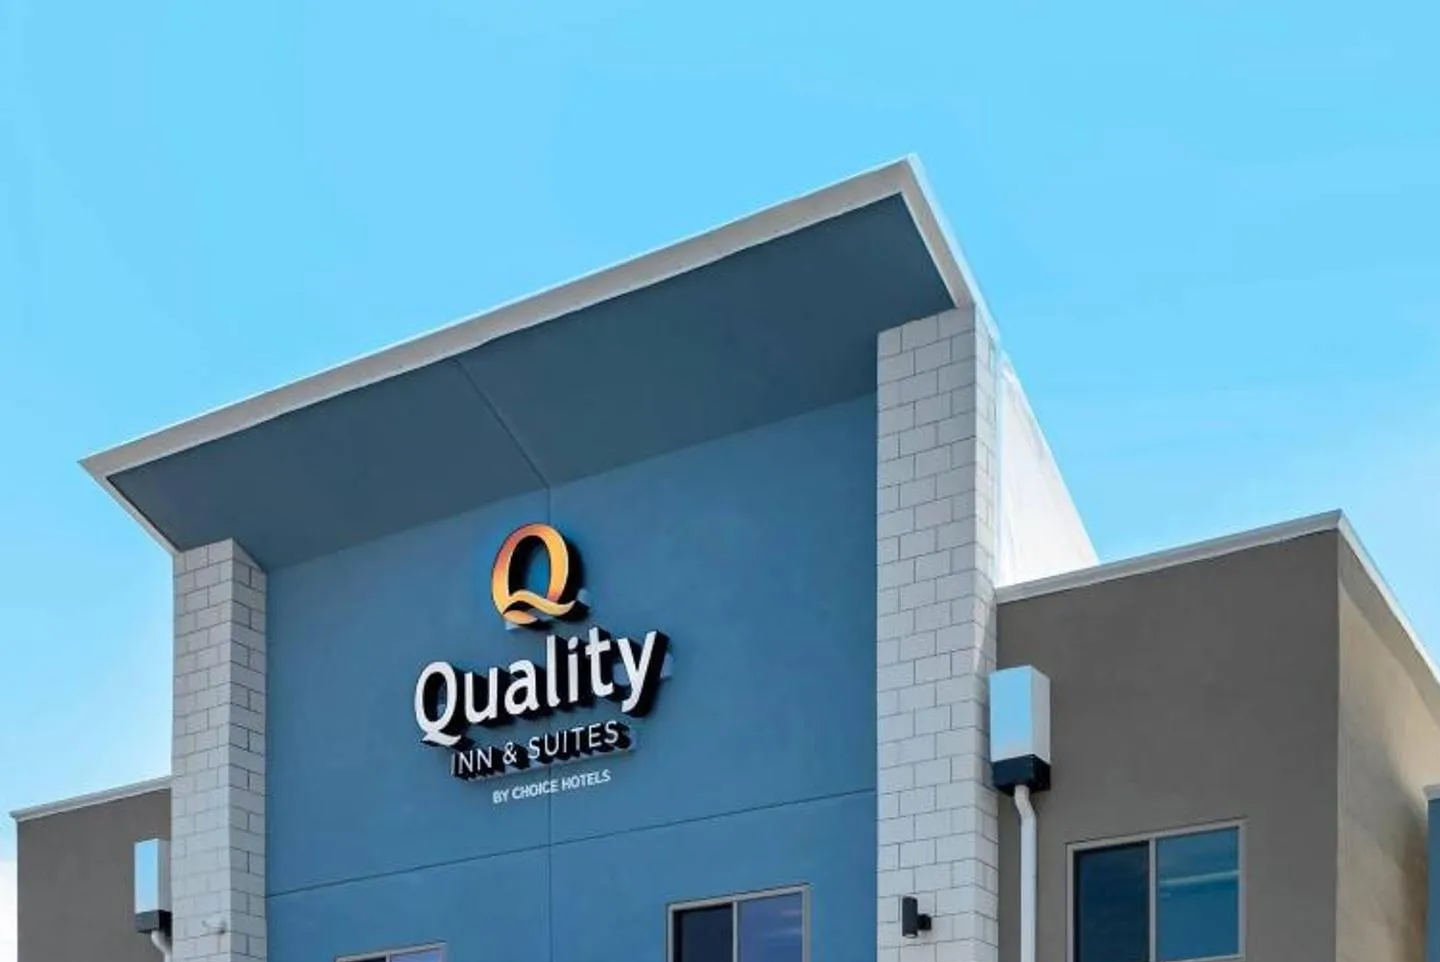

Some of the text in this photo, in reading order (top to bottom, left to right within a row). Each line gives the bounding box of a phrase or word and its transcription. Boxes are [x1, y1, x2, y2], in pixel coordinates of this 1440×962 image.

[491, 522, 575, 624] Q
[414, 627, 657, 745] Quality
[451, 720, 620, 775] INN & SUITES
[492, 769, 611, 804] BY CHOICE HOTELS
